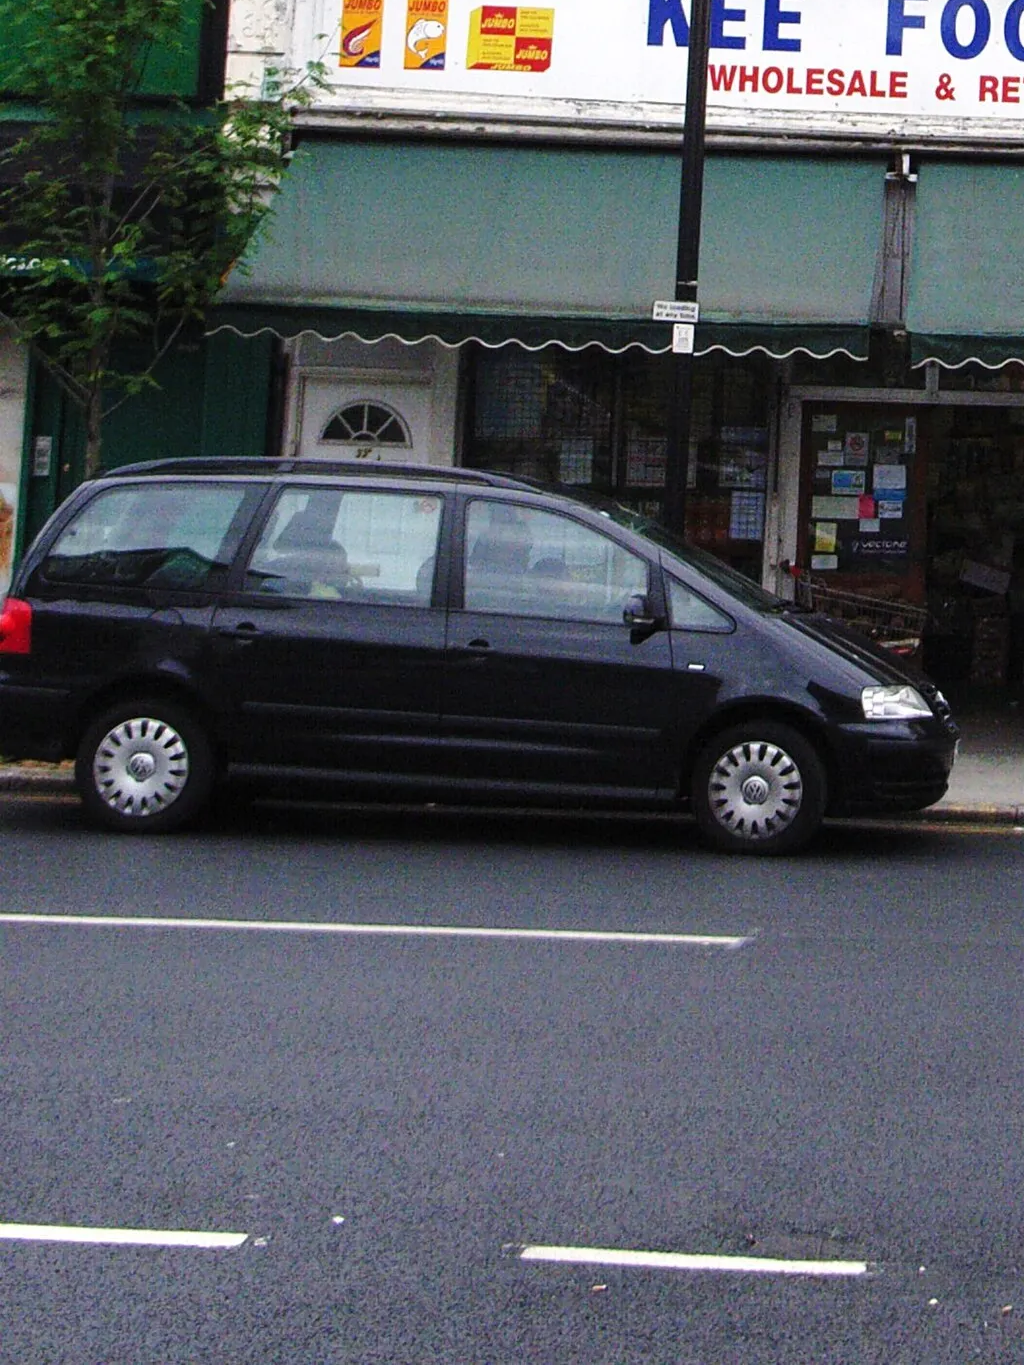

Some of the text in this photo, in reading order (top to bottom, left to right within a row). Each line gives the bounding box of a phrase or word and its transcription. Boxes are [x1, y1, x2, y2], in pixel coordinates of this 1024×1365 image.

[408, 0, 446, 13] JUMBO
[481, 16, 515, 30] JUMBO
[515, 47, 549, 61] JUMBO
[707, 64, 908, 98] WHOLESALE
[935, 73, 955, 101] &
